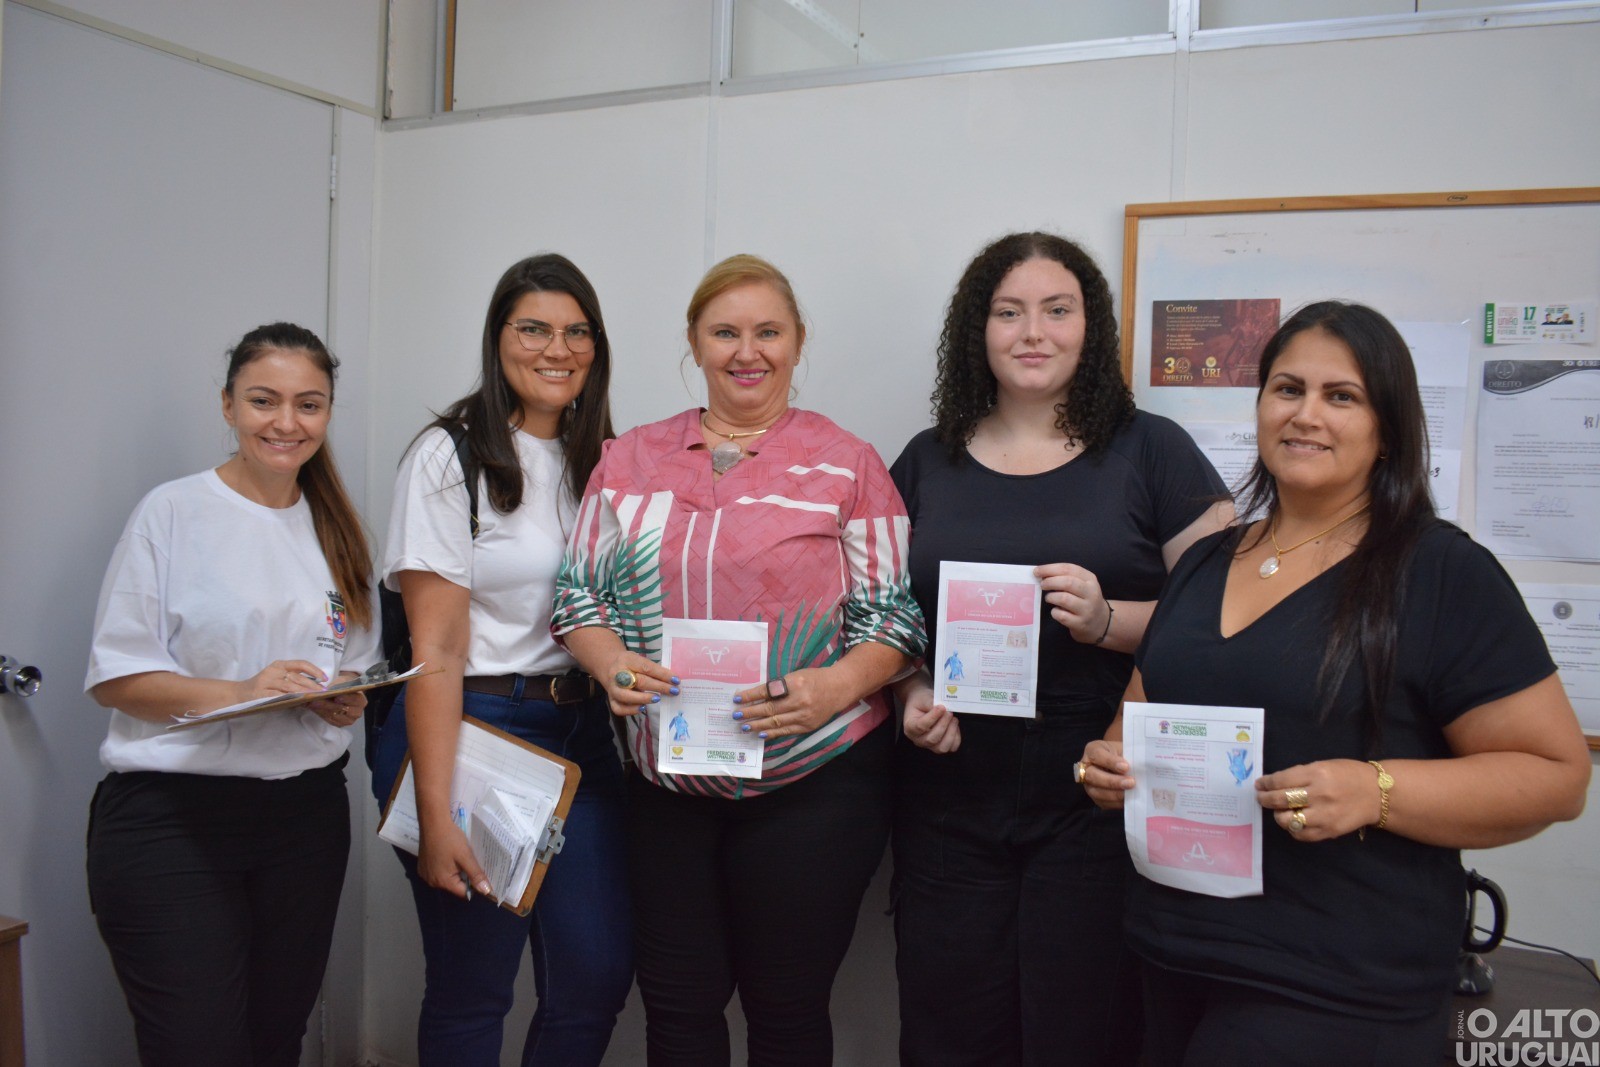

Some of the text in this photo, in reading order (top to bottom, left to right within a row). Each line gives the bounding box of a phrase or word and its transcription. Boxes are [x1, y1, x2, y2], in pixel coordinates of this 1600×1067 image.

[1165, 303, 1198, 313] Convite
[1523, 306, 1537, 320] 17
[1201, 368, 1221, 378] URI
[1162, 374, 1193, 382] DIREITO
[1488, 380, 1522, 388] DIREITO
[1172, 729, 1208, 737] FREDERICO
